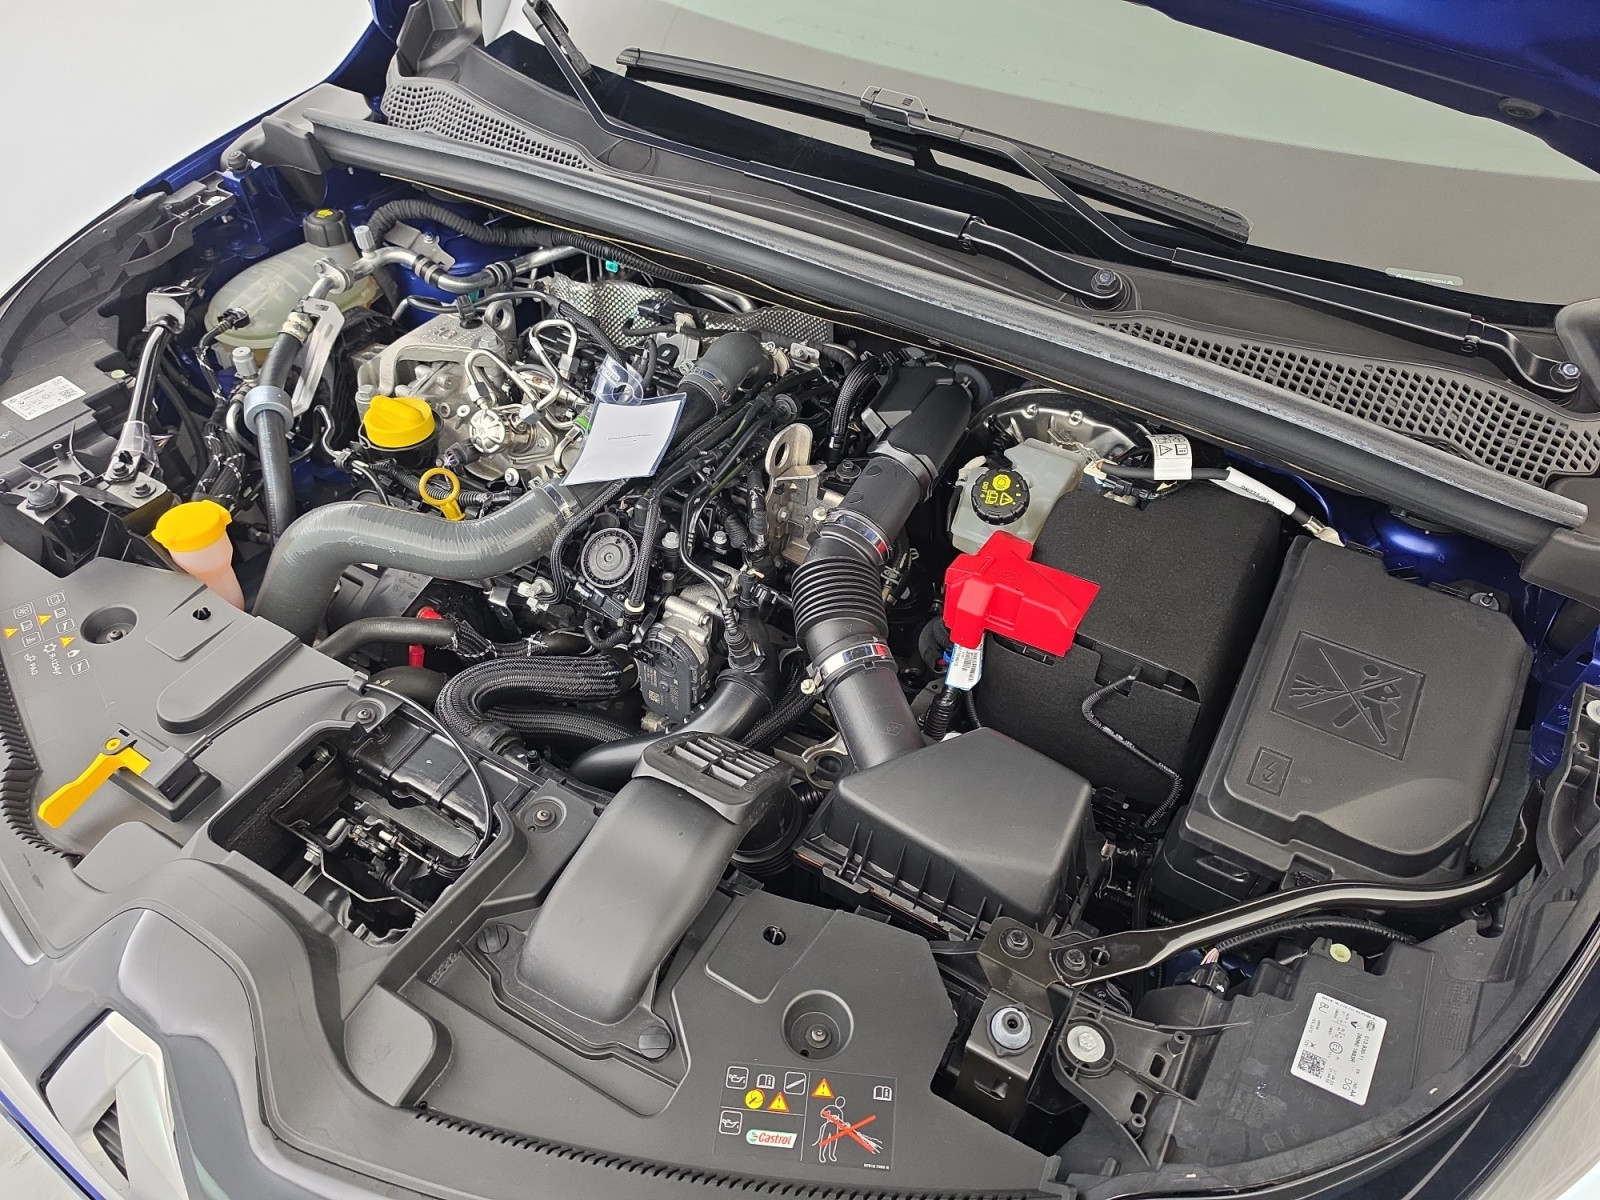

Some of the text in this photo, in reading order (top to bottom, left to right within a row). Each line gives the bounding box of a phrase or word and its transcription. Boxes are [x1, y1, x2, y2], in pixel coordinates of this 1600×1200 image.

[29, 663, 38, 676] PAG
[1341, 1077, 1352, 1091] DG
[757, 1131, 792, 1146] Castrol
